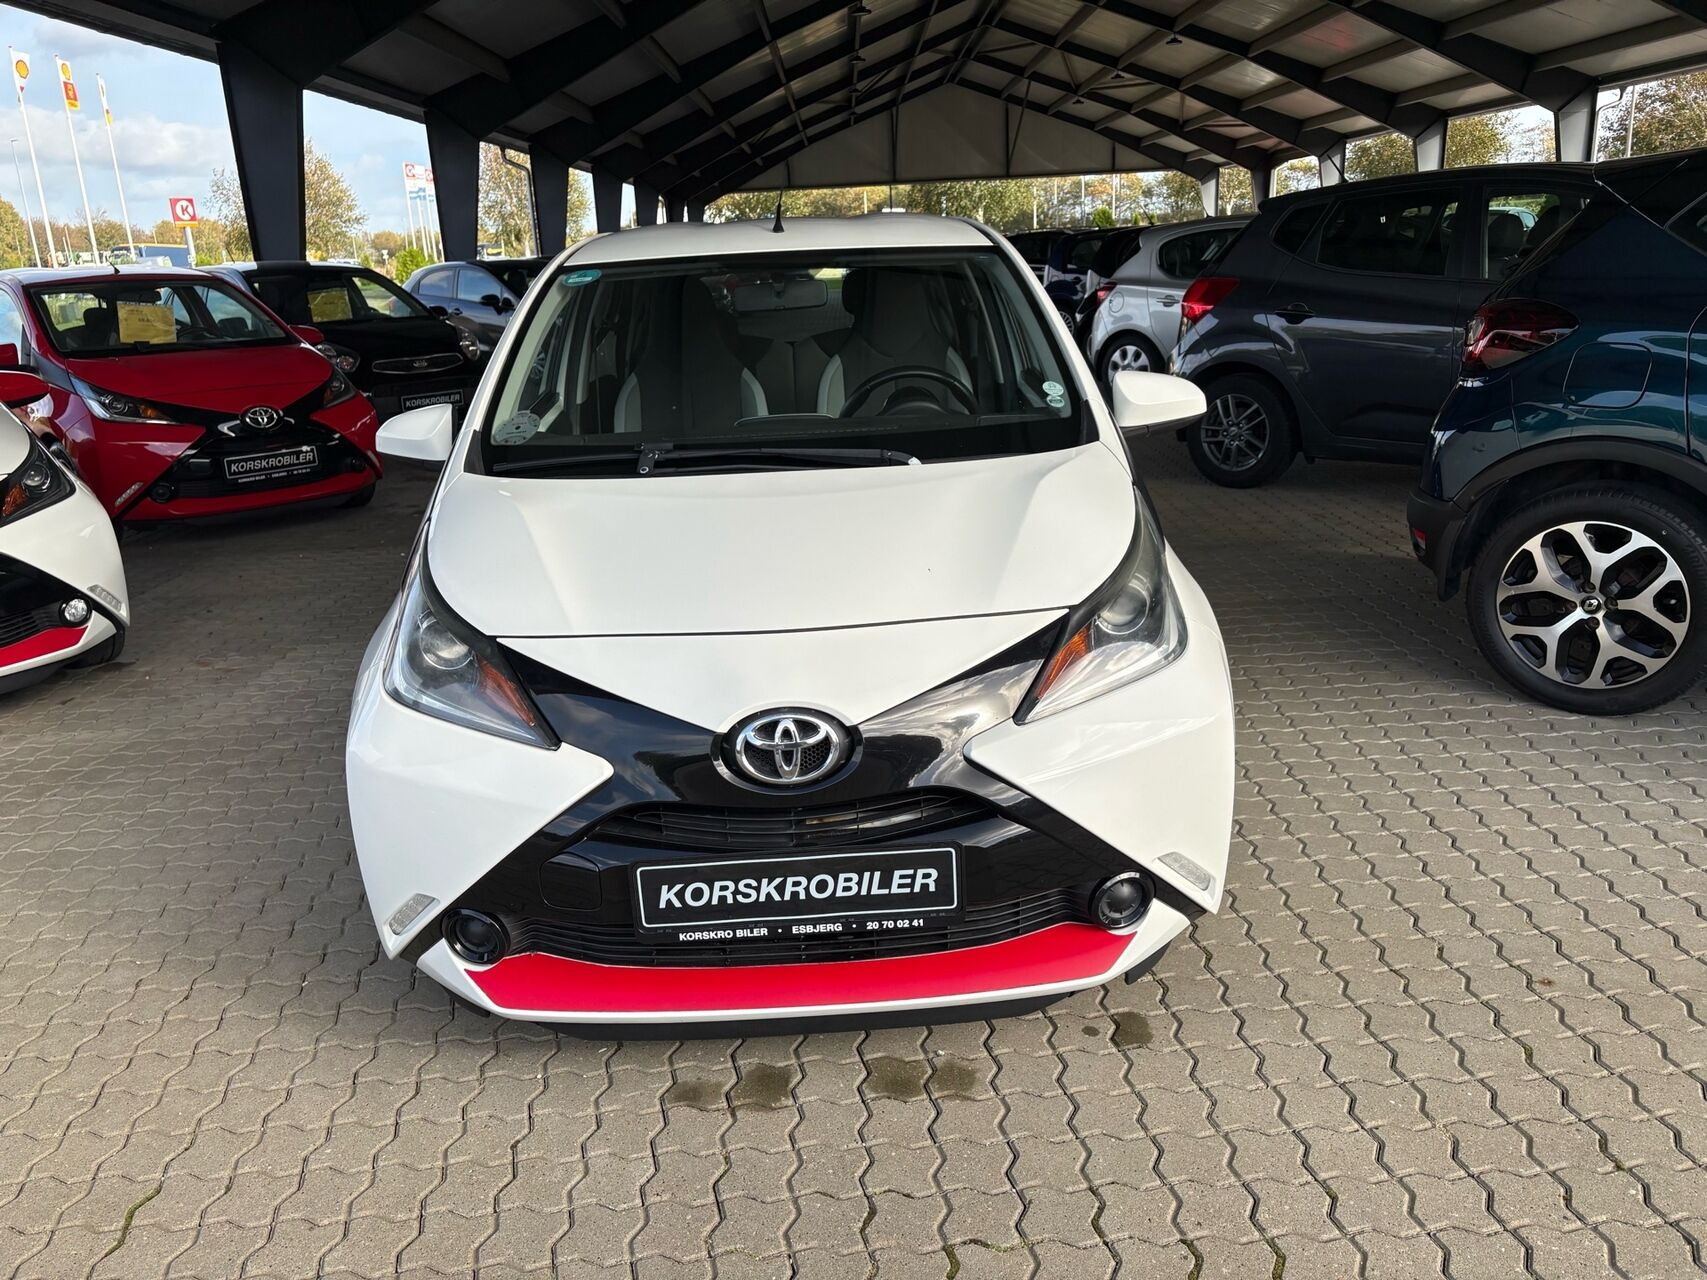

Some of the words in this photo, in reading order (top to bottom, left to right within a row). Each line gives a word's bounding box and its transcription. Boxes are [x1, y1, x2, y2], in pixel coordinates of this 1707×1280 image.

[180, 204, 193, 217] K
[405, 394, 460, 408] KORSKROBILER
[231, 452, 314, 473] KORSKROBILER
[658, 867, 939, 909] KORSKROBILER
[679, 929, 733, 941] KORSKRO
[736, 927, 768, 938] BILER
[792, 922, 842, 934] ESBJERG
[866, 921, 879, 930] 20
[881, 920, 895, 929] 70
[896, 919, 910, 928] 02
[911, 918, 924, 927] 41
